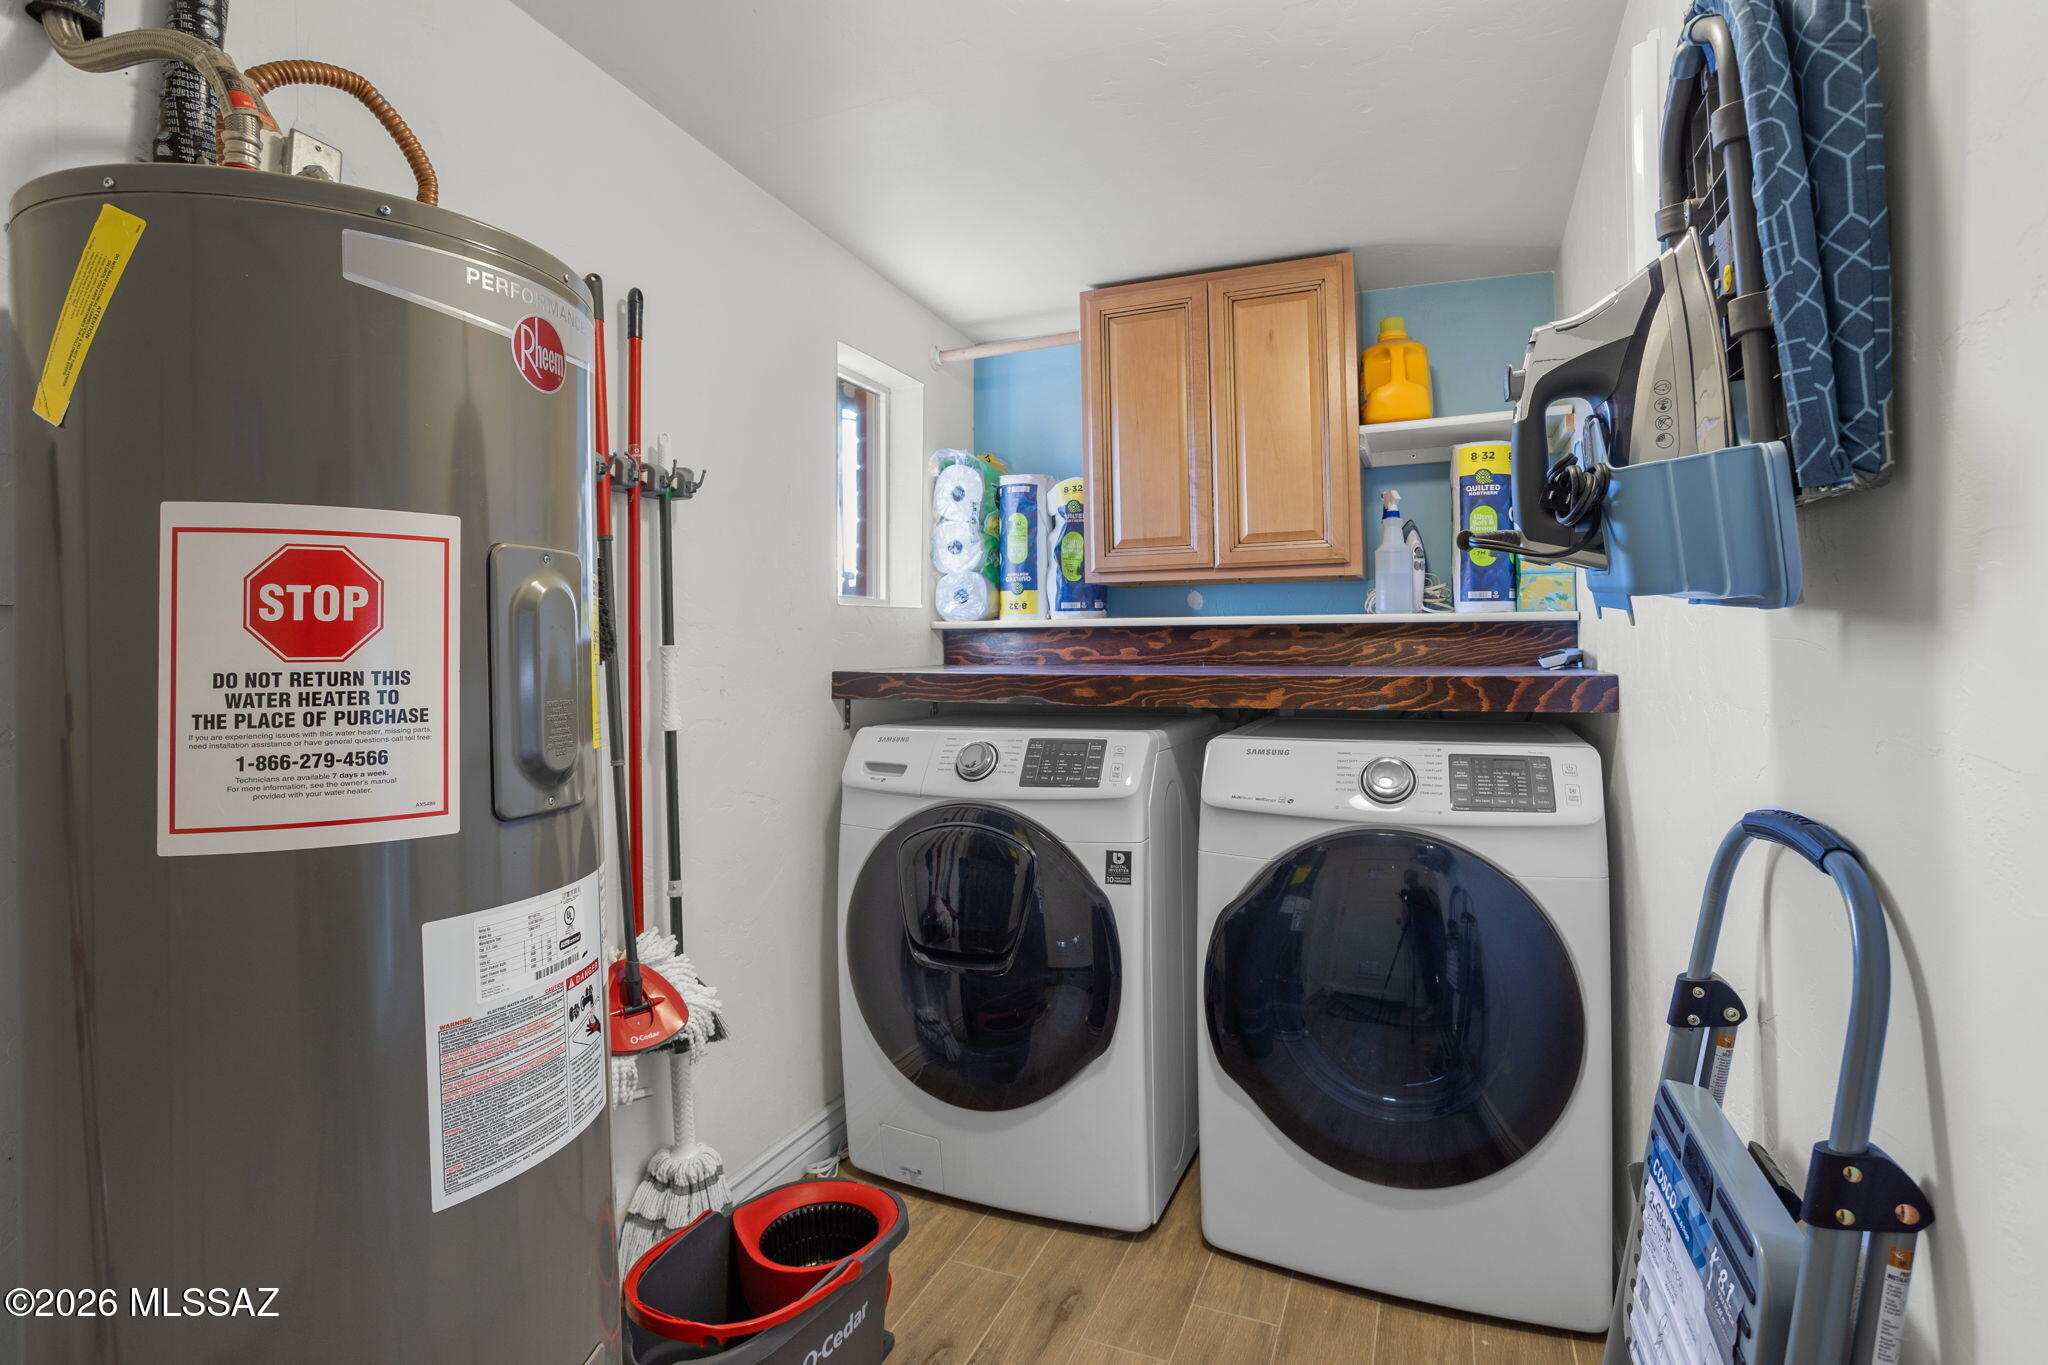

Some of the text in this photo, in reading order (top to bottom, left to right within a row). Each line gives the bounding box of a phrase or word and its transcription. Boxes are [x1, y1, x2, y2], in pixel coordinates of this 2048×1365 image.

[466, 266, 585, 335] PERFORMANCE
[520, 317, 564, 379] Rheem
[1466, 484, 1501, 492] QUILTED
[258, 583, 369, 622] STOP
[213, 669, 411, 689] DO NOT RETURN THIS
[225, 689, 400, 709] WATER HEATER TO
[192, 707, 429, 731] THE PLACE OF PURCHASE
[195, 735, 209, 743] you
[225, 732, 273, 742] experiencing
[357, 728, 383, 736] heater,
[384, 727, 411, 735] missing
[209, 741, 249, 749] installation
[251, 740, 291, 748] assistance
[324, 738, 353, 746] general
[354, 736, 389, 744] questions
[235, 749, 389, 772] 1-866-279-4566
[1246, 748, 1290, 756] SAMSUNG
[263, 783, 308, 791] information,
[370, 777, 397, 785] manual
[297, 773, 330, 781] available
[339, 772, 358, 780] days
[252, 793, 286, 801] provided
[305, 791, 322, 799] your
[346, 787, 372, 795] heater.
[575, 962, 598, 983] DANGER
[545, 982, 564, 994] CAUTION
[439, 1017, 473, 1031] WARNING
[1652, 1158, 1677, 1209] COSCO
[1649, 1190, 1671, 1243] 2-Step
